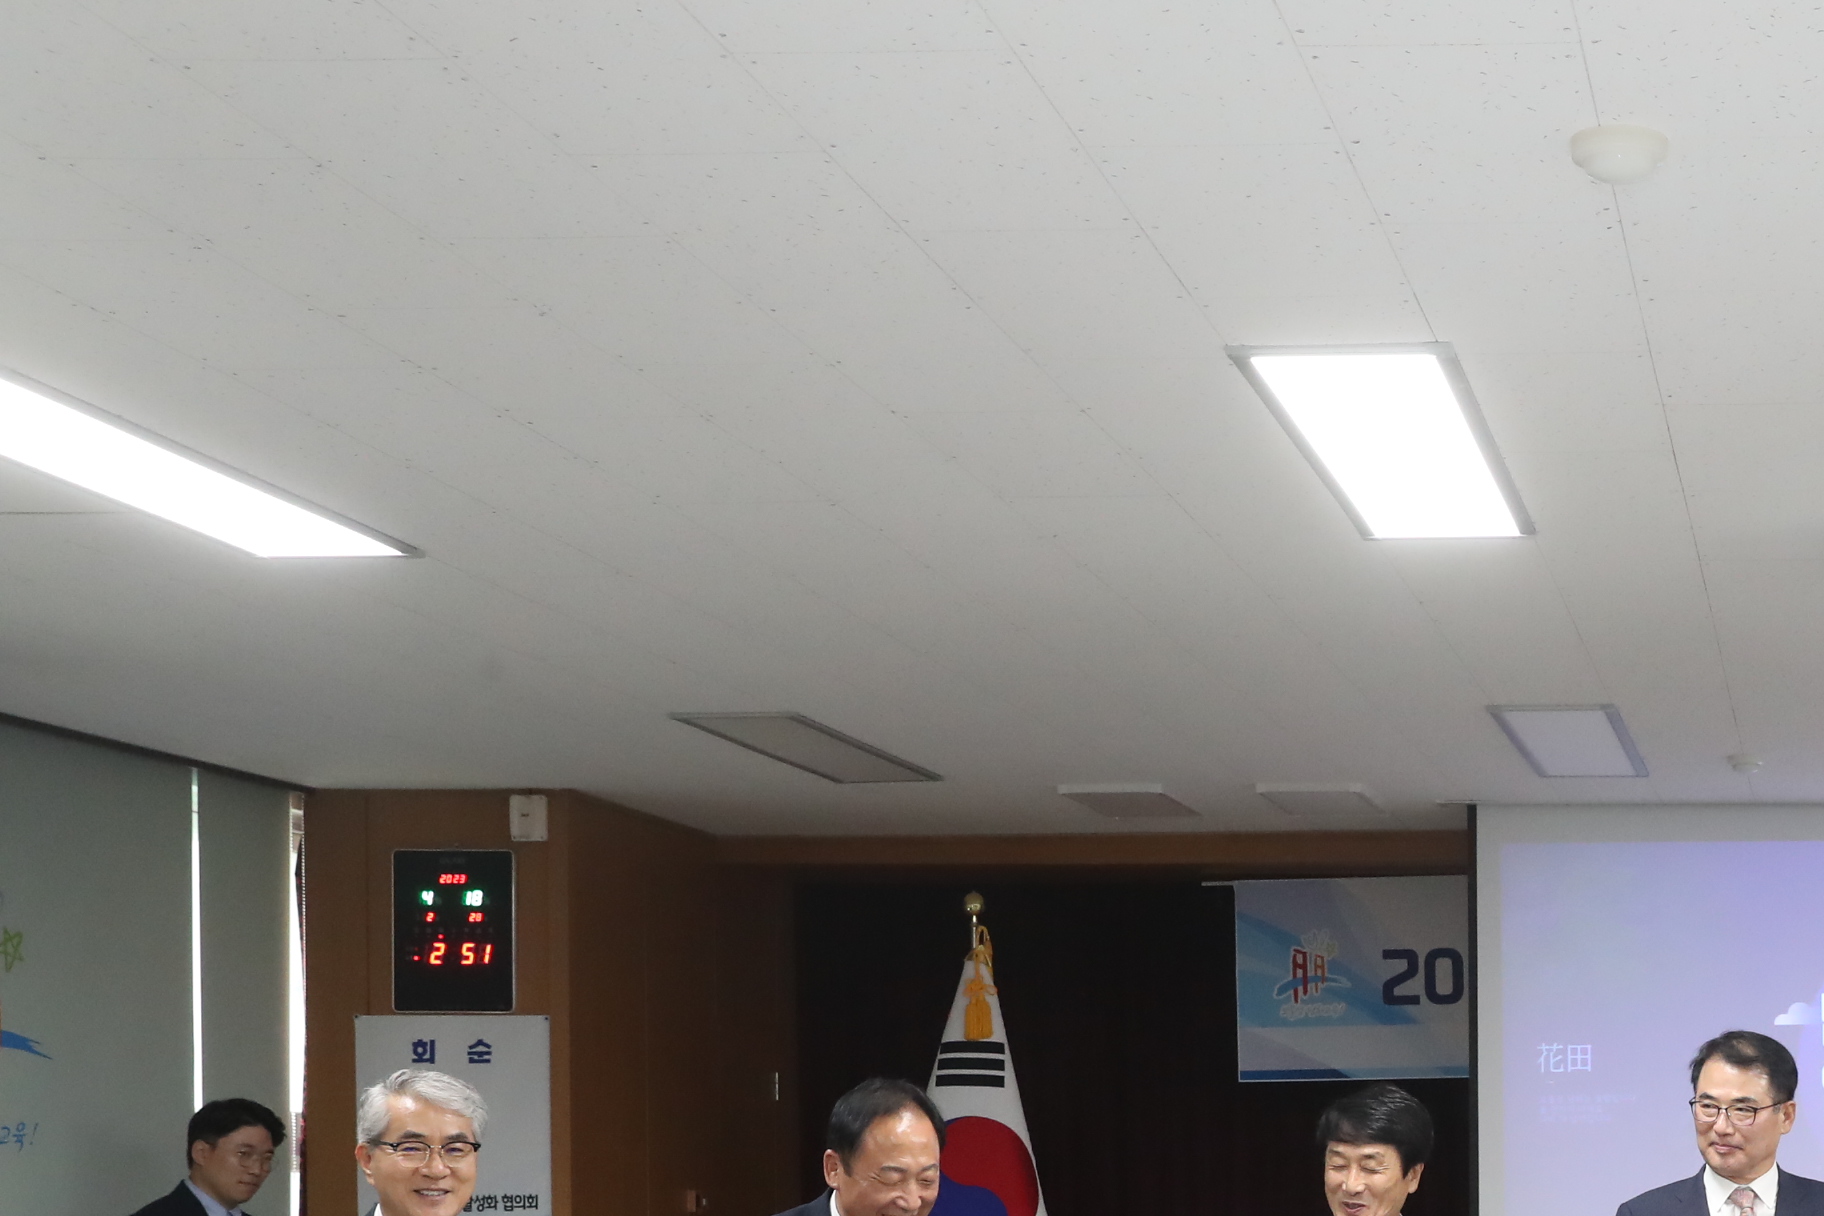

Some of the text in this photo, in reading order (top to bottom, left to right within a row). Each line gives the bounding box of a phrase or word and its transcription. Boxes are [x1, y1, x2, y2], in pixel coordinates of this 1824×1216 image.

[438, 873, 468, 885] 2023
[420, 889, 484, 907] 4 18
[425, 911, 436, 922] 2
[429, 942, 494, 966] 2 51
[1381, 947, 1464, 1006] 20
[1537, 1042, 1593, 1073] 花田
[501, 1194, 539, 1212] 협의회
